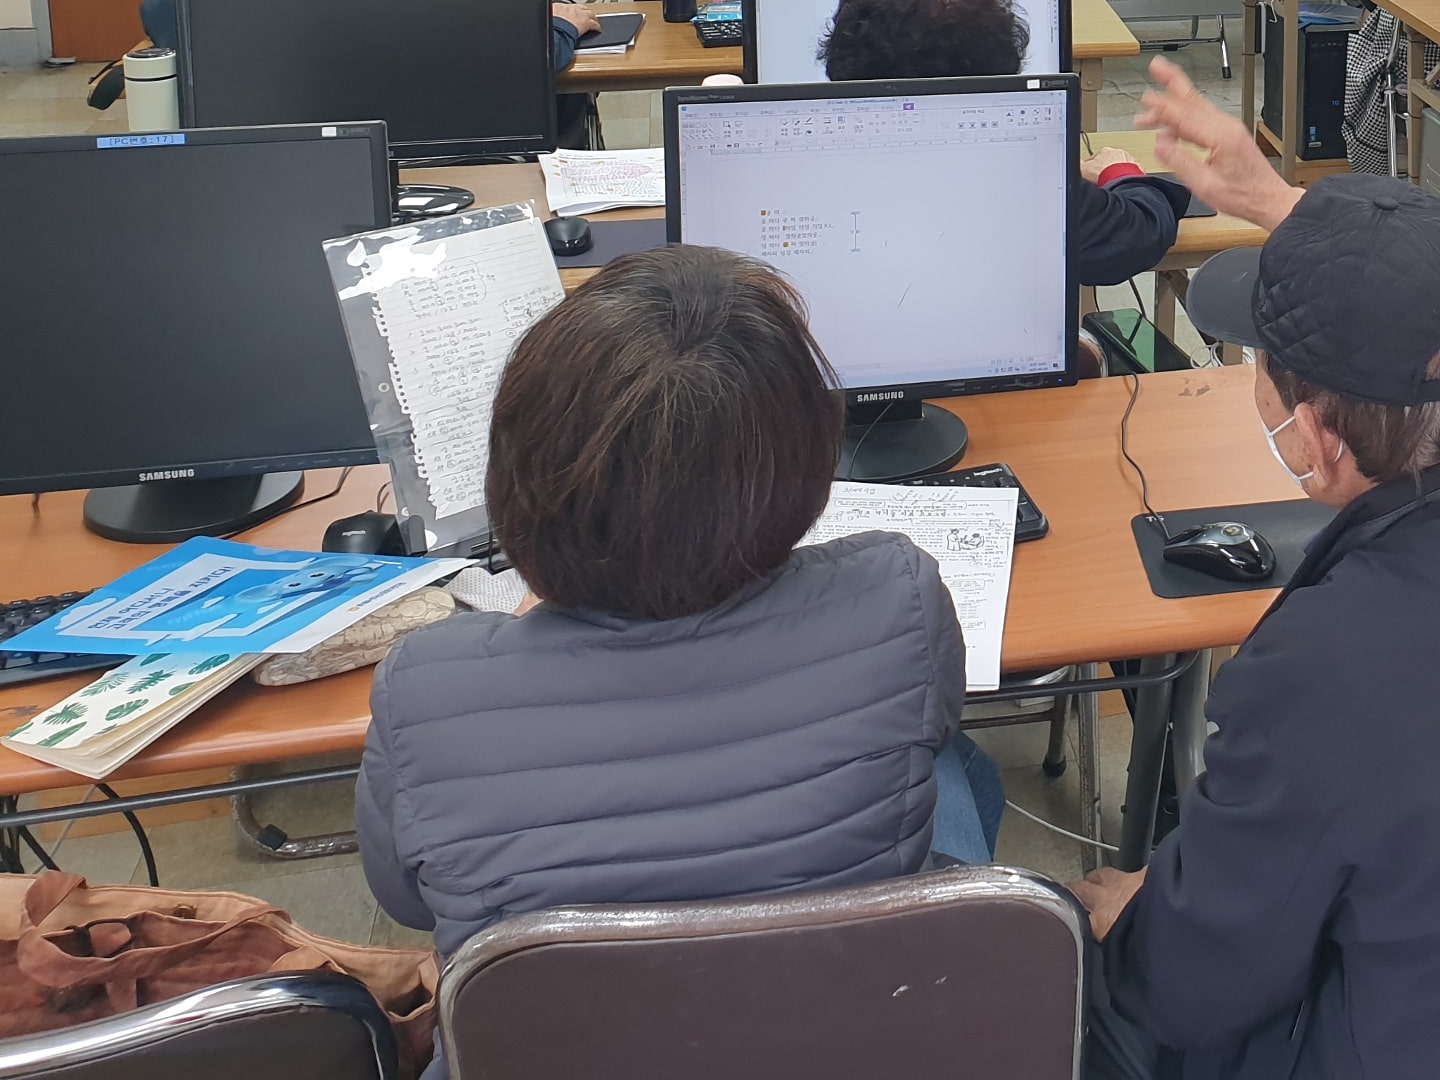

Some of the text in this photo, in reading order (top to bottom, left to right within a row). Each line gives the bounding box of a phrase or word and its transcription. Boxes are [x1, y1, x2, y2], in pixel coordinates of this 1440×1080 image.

[857, 390, 904, 403] SAMSUNG
[138, 469, 195, 482] SAMSUNG
[119, 587, 175, 614] 어디서나
